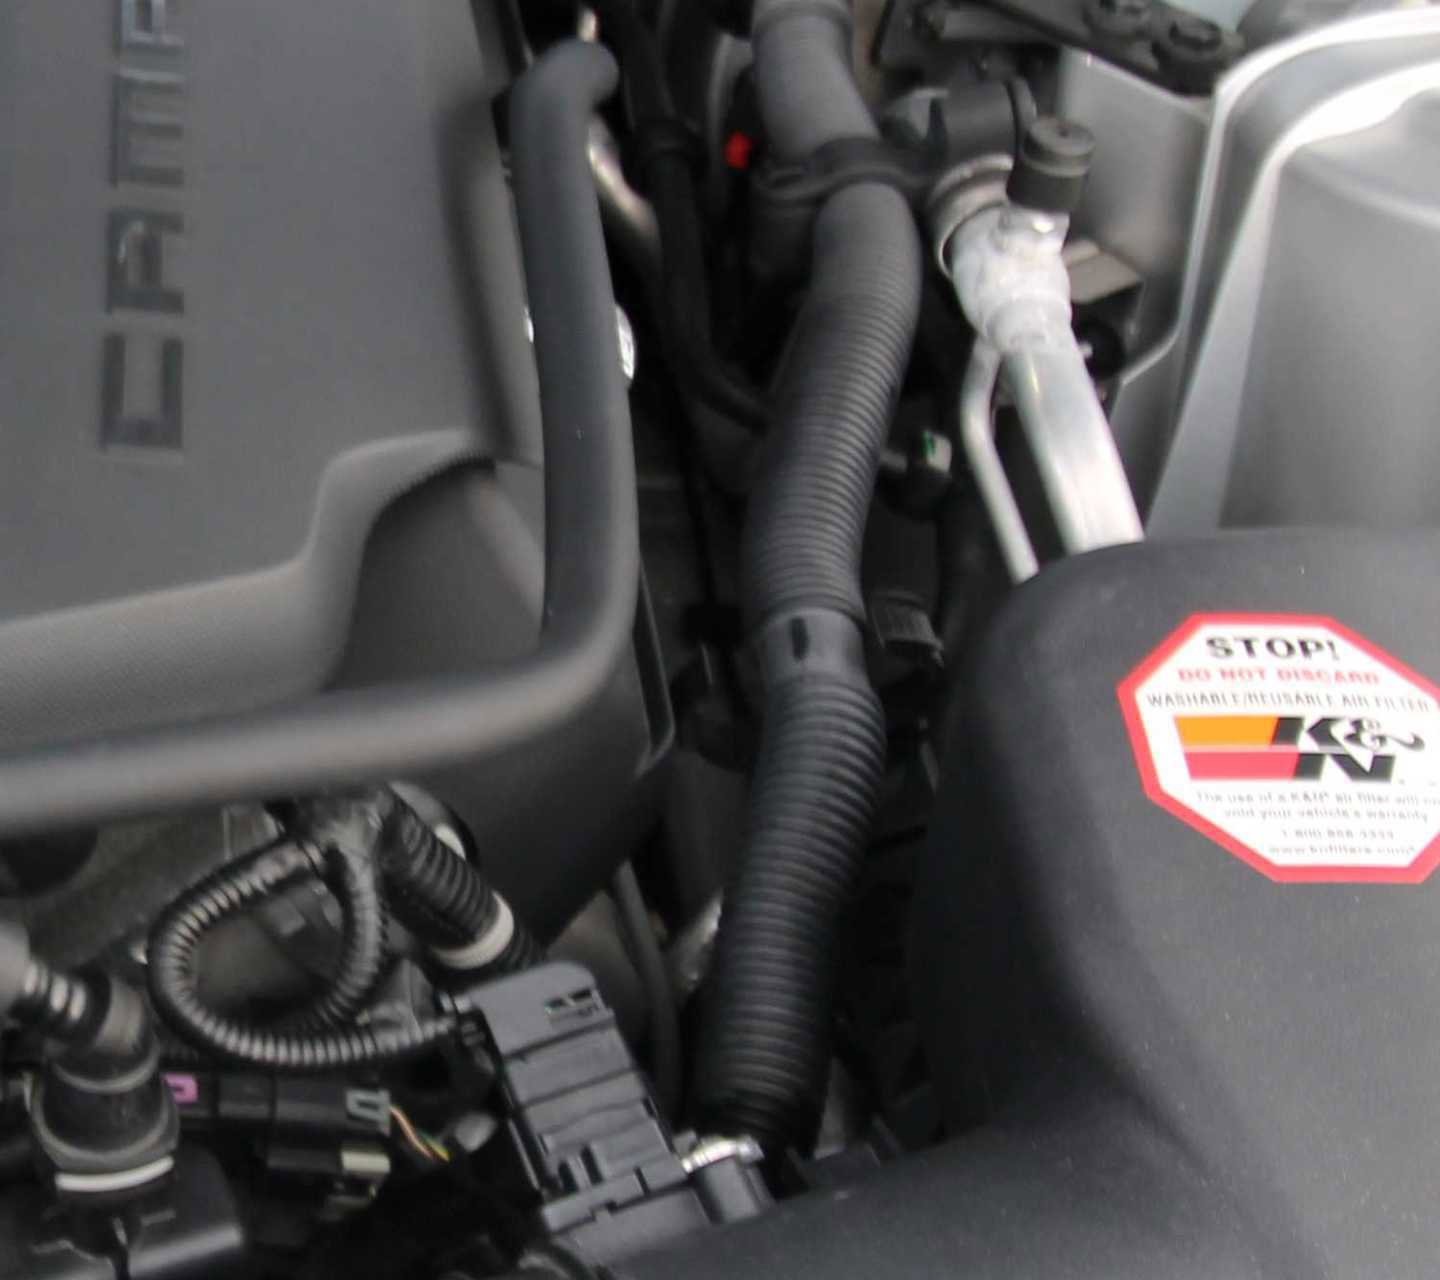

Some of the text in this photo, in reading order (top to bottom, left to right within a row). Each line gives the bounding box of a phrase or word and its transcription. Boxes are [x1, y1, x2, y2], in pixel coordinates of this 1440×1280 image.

[1205, 635, 1340, 661] STOP!
[1177, 667, 1380, 686] DO NOT DISCARD
[1270, 716, 1426, 783] K&N
